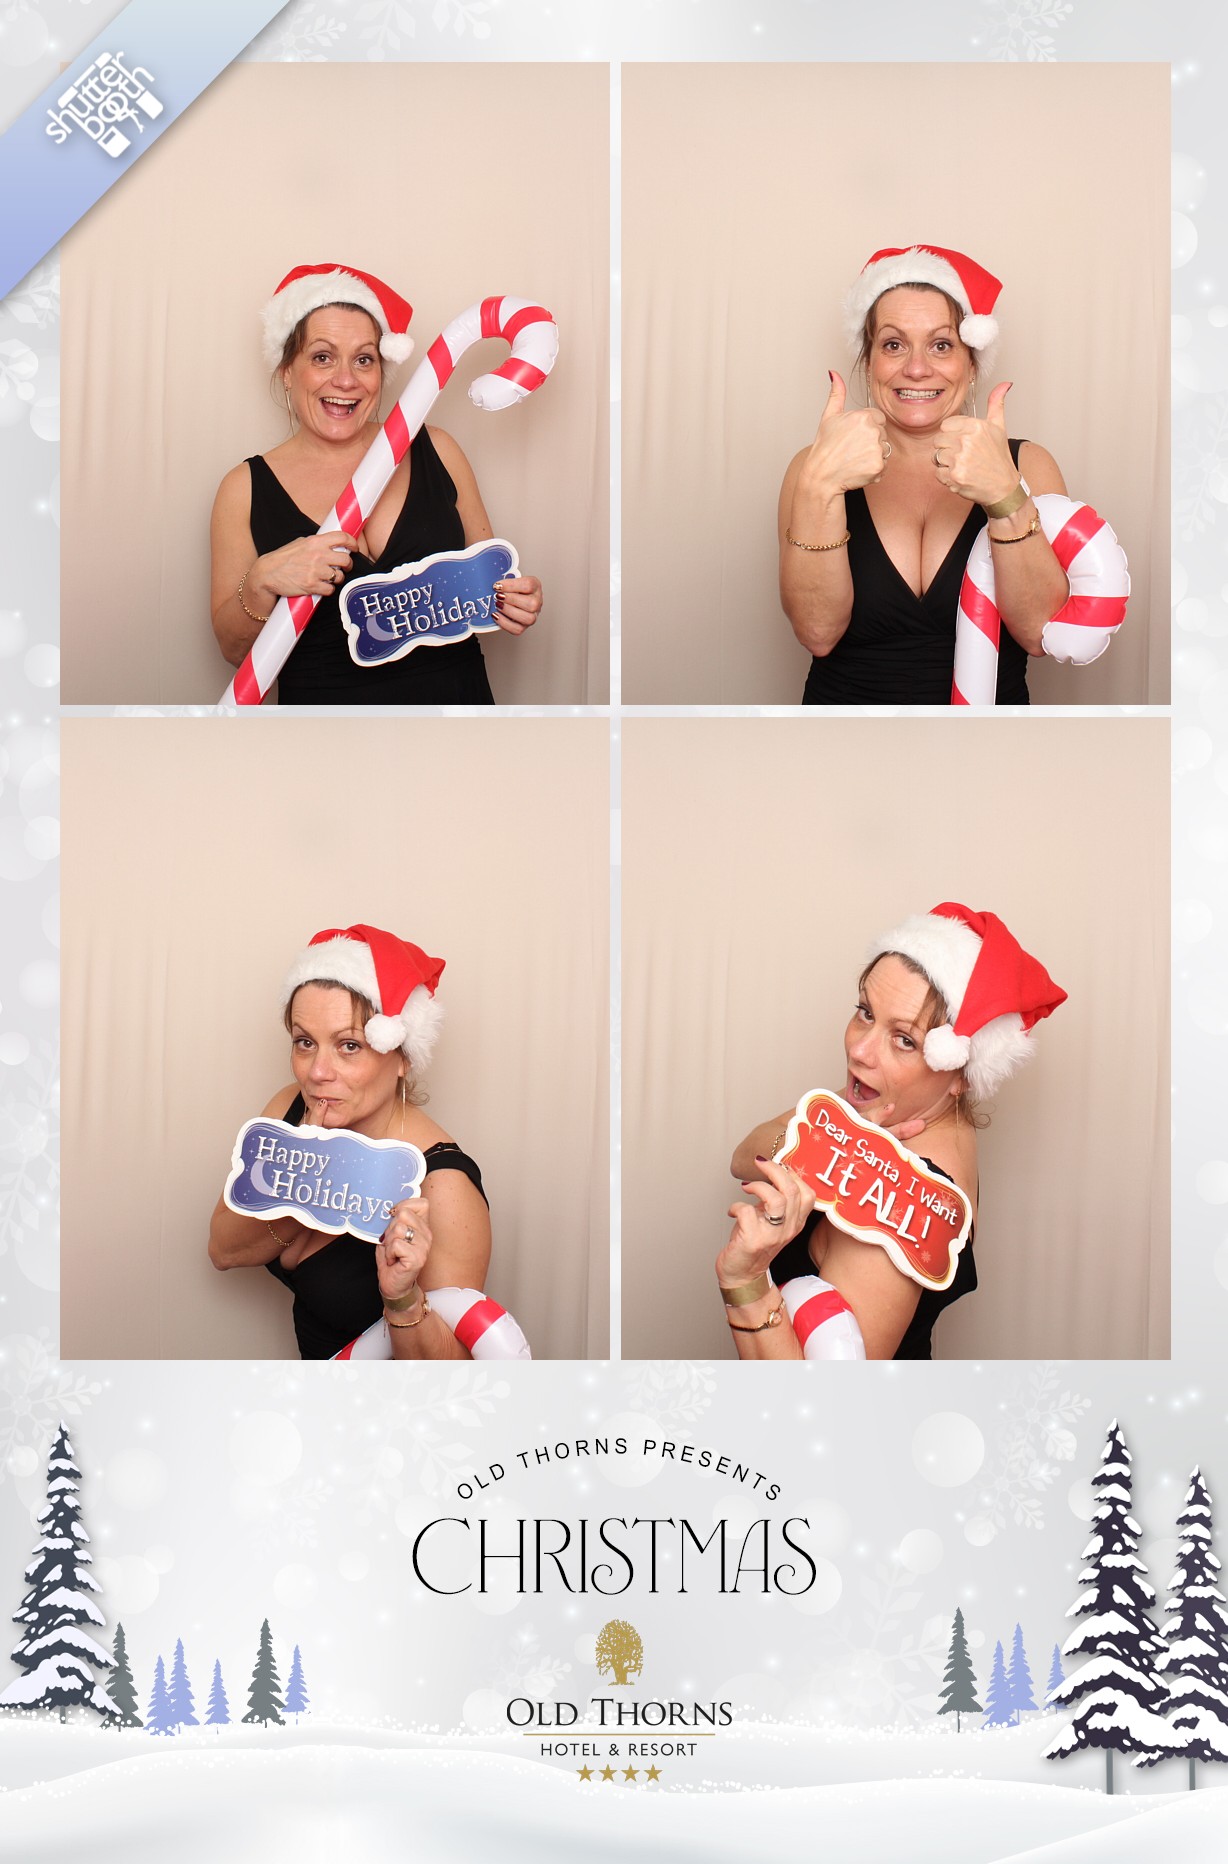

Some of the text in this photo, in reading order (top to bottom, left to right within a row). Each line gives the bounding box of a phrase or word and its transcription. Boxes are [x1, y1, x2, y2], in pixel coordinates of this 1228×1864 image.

[360, 582, 433, 618] Happy
[255, 1136, 331, 1176] Happy
[815, 1109, 958, 1226] Dear Santa, I Want
[269, 1169, 394, 1223] Holidays
[815, 1146, 931, 1249] It ALL!
